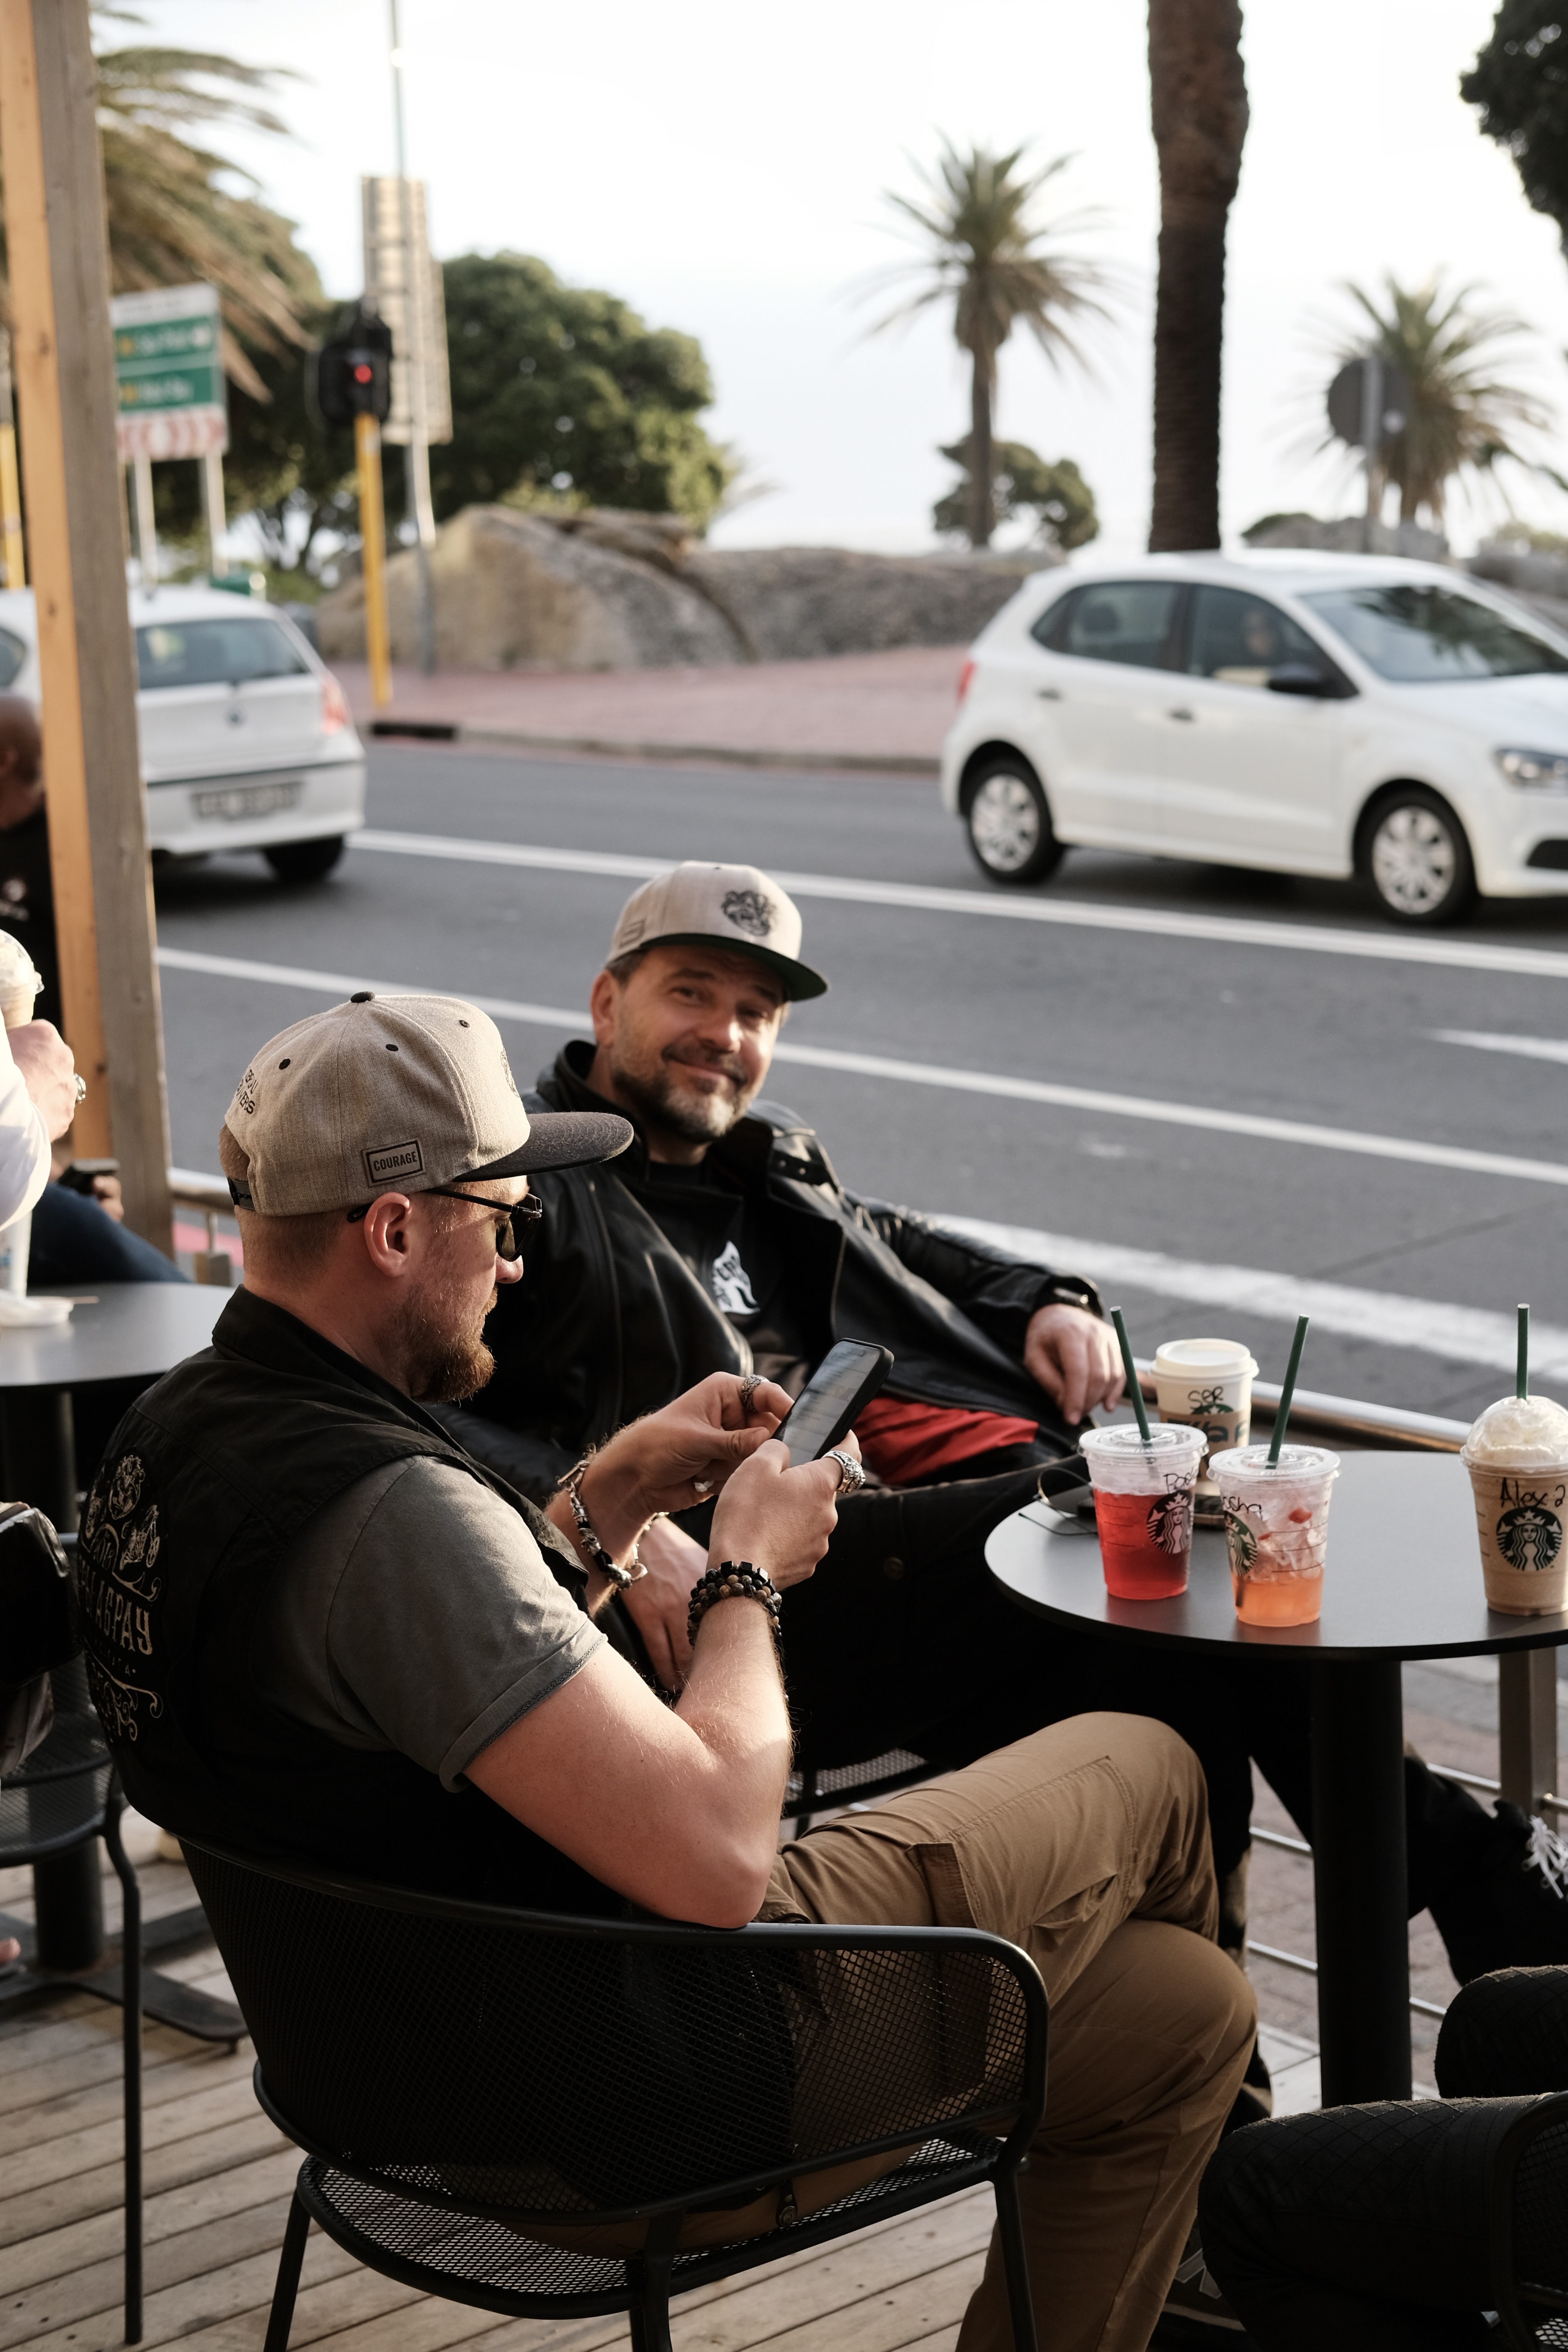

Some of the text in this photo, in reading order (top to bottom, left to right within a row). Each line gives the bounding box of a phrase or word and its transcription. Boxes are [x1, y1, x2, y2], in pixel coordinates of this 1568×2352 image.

[373, 1151, 417, 1171] COURAGE
[1500, 1477, 1548, 1509] Alex
[95, 1579, 153, 1656] АБРАУ
